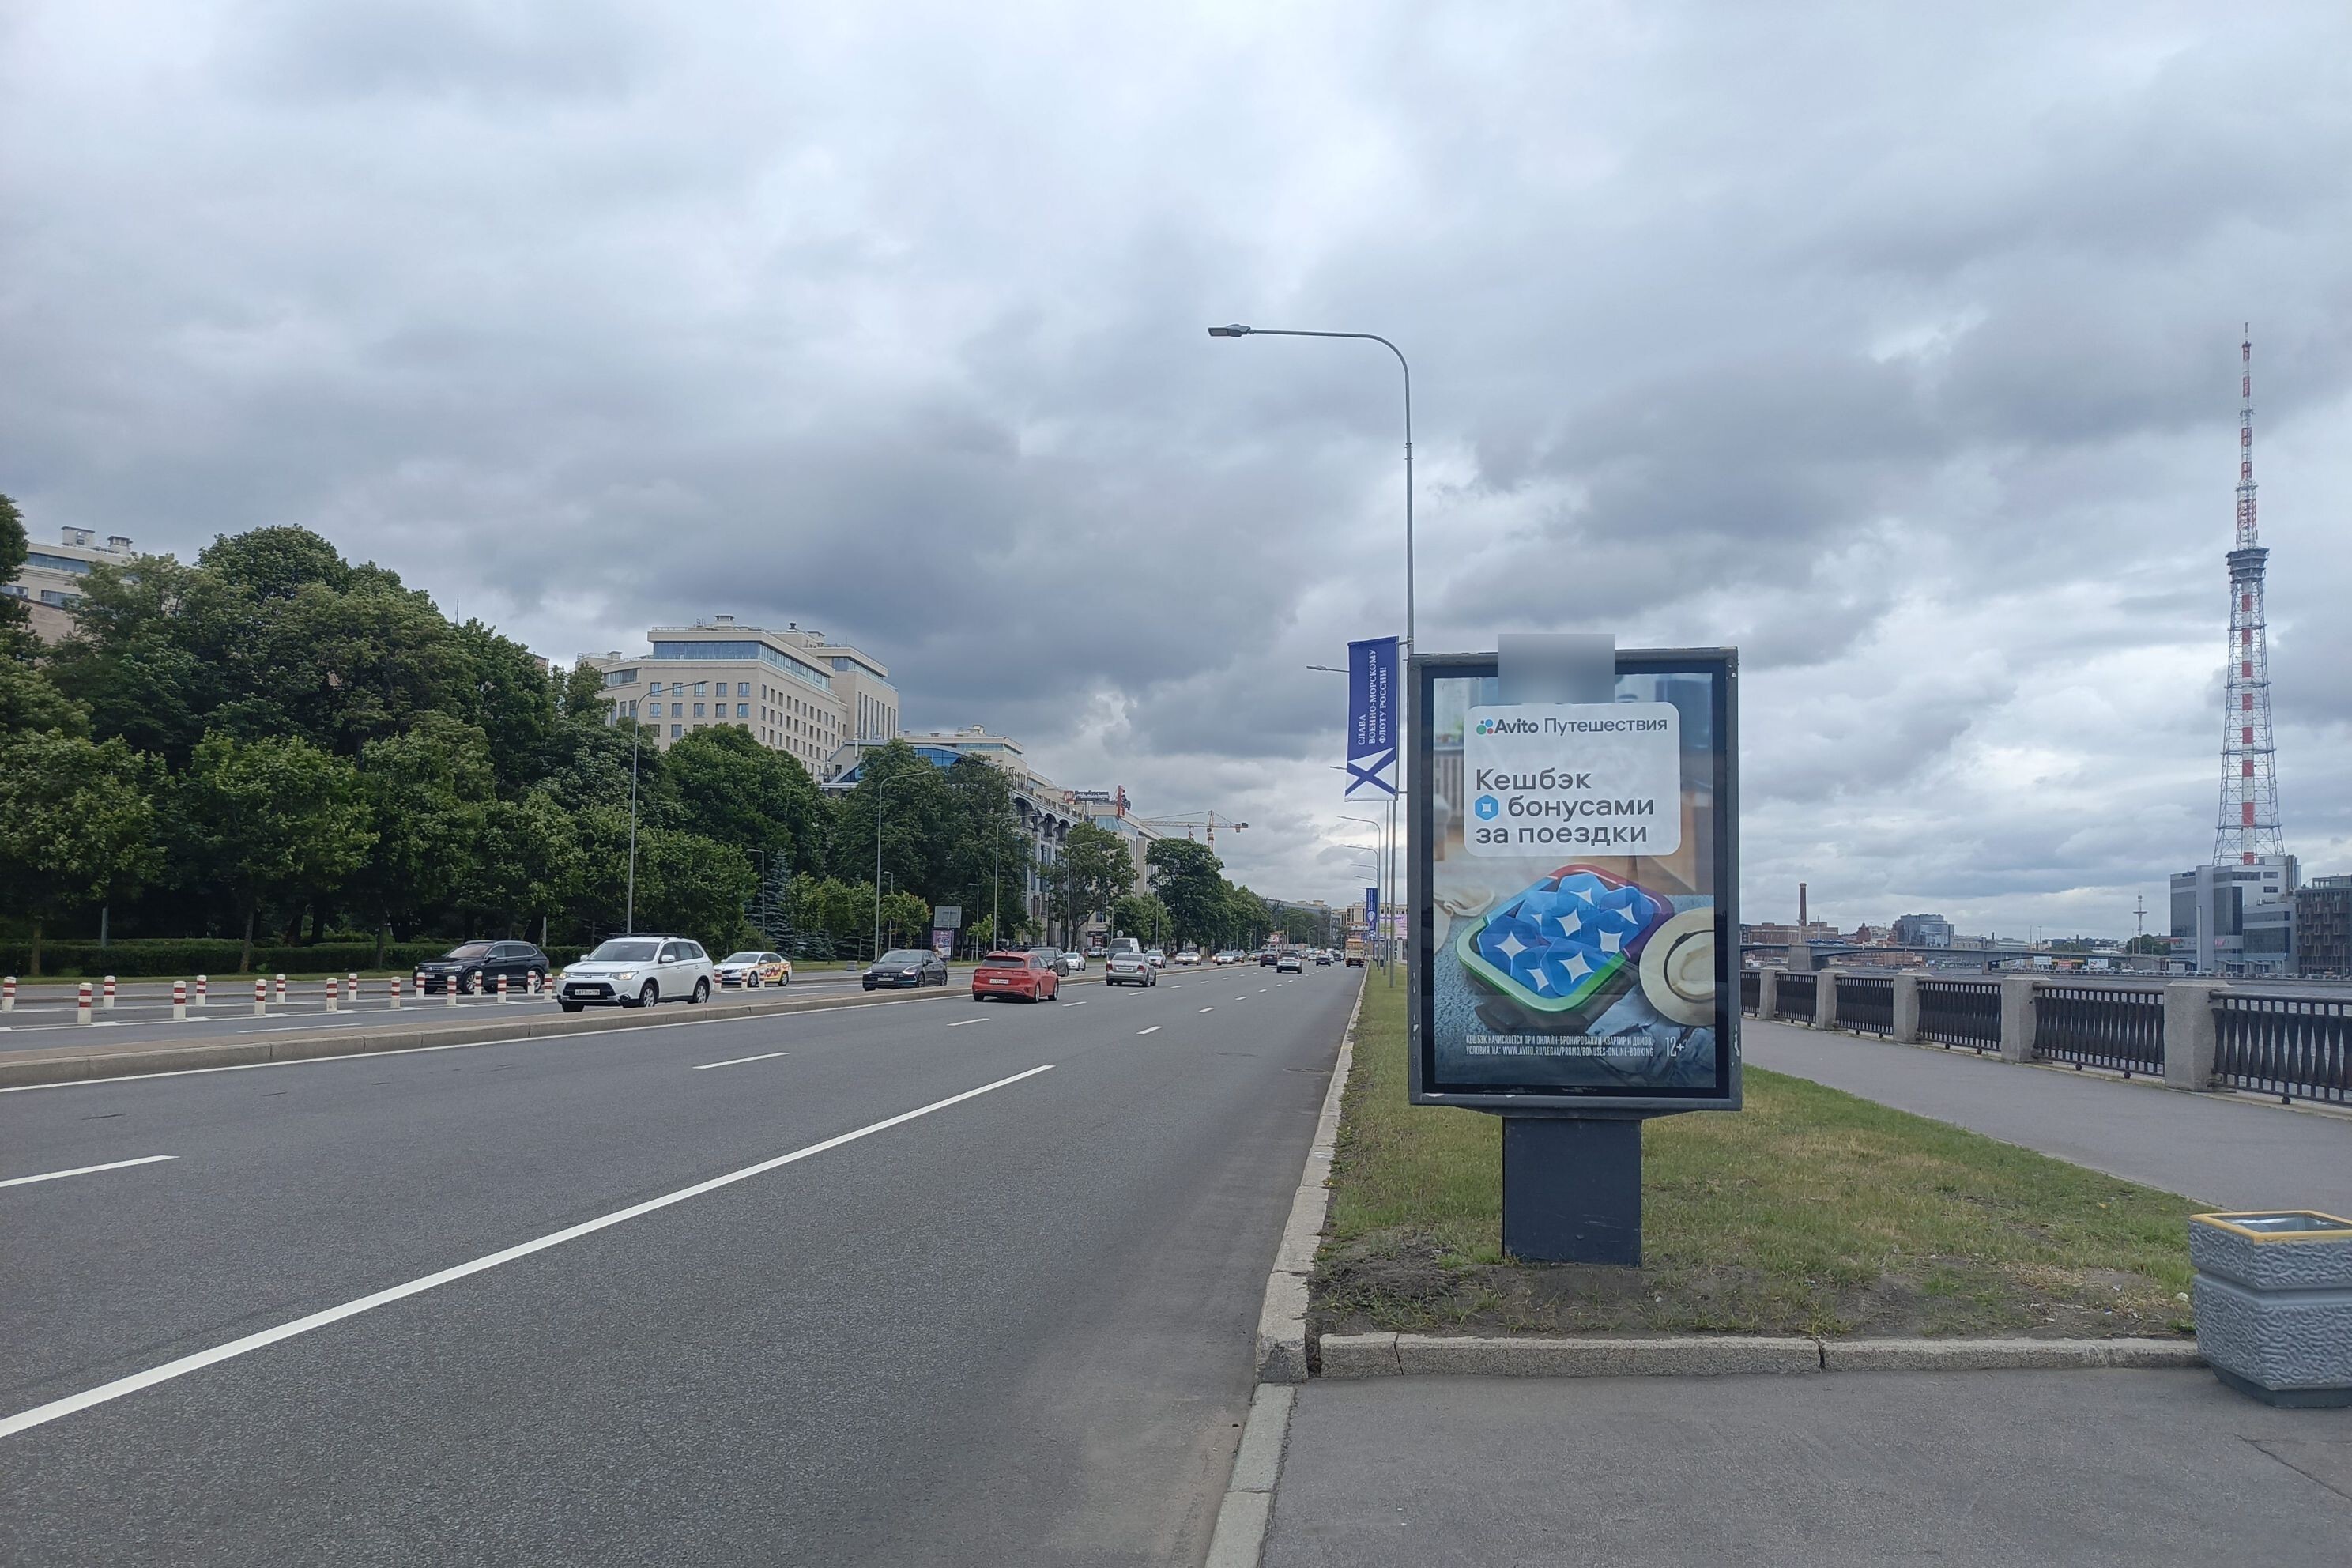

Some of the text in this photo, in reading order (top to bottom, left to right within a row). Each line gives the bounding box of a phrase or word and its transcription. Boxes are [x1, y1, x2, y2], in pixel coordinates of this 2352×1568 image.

[1494, 718, 1539, 734] Avito
[1544, 718, 1668, 736] Путешествия
[1476, 767, 1592, 790] Кешбэк
[1508, 795, 1654, 821] бонусами
[1476, 826, 1647, 846] за поездки
[1466, 1035, 1487, 1044] КЕШБЭК
[1488, 1035, 1523, 1044] НАЧИСЛЯЕТСЯ
[1525, 1035, 1535, 1044] ПРИ
[1604, 1036, 1626, 1046] КВАРТИР
[1627, 1037, 1631, 1046] И
[1466, 1046, 1490, 1054] УСЛОВИЯ
[1492, 1046, 1501, 1054] НА:
[1665, 1036, 1684, 1057] 12+
